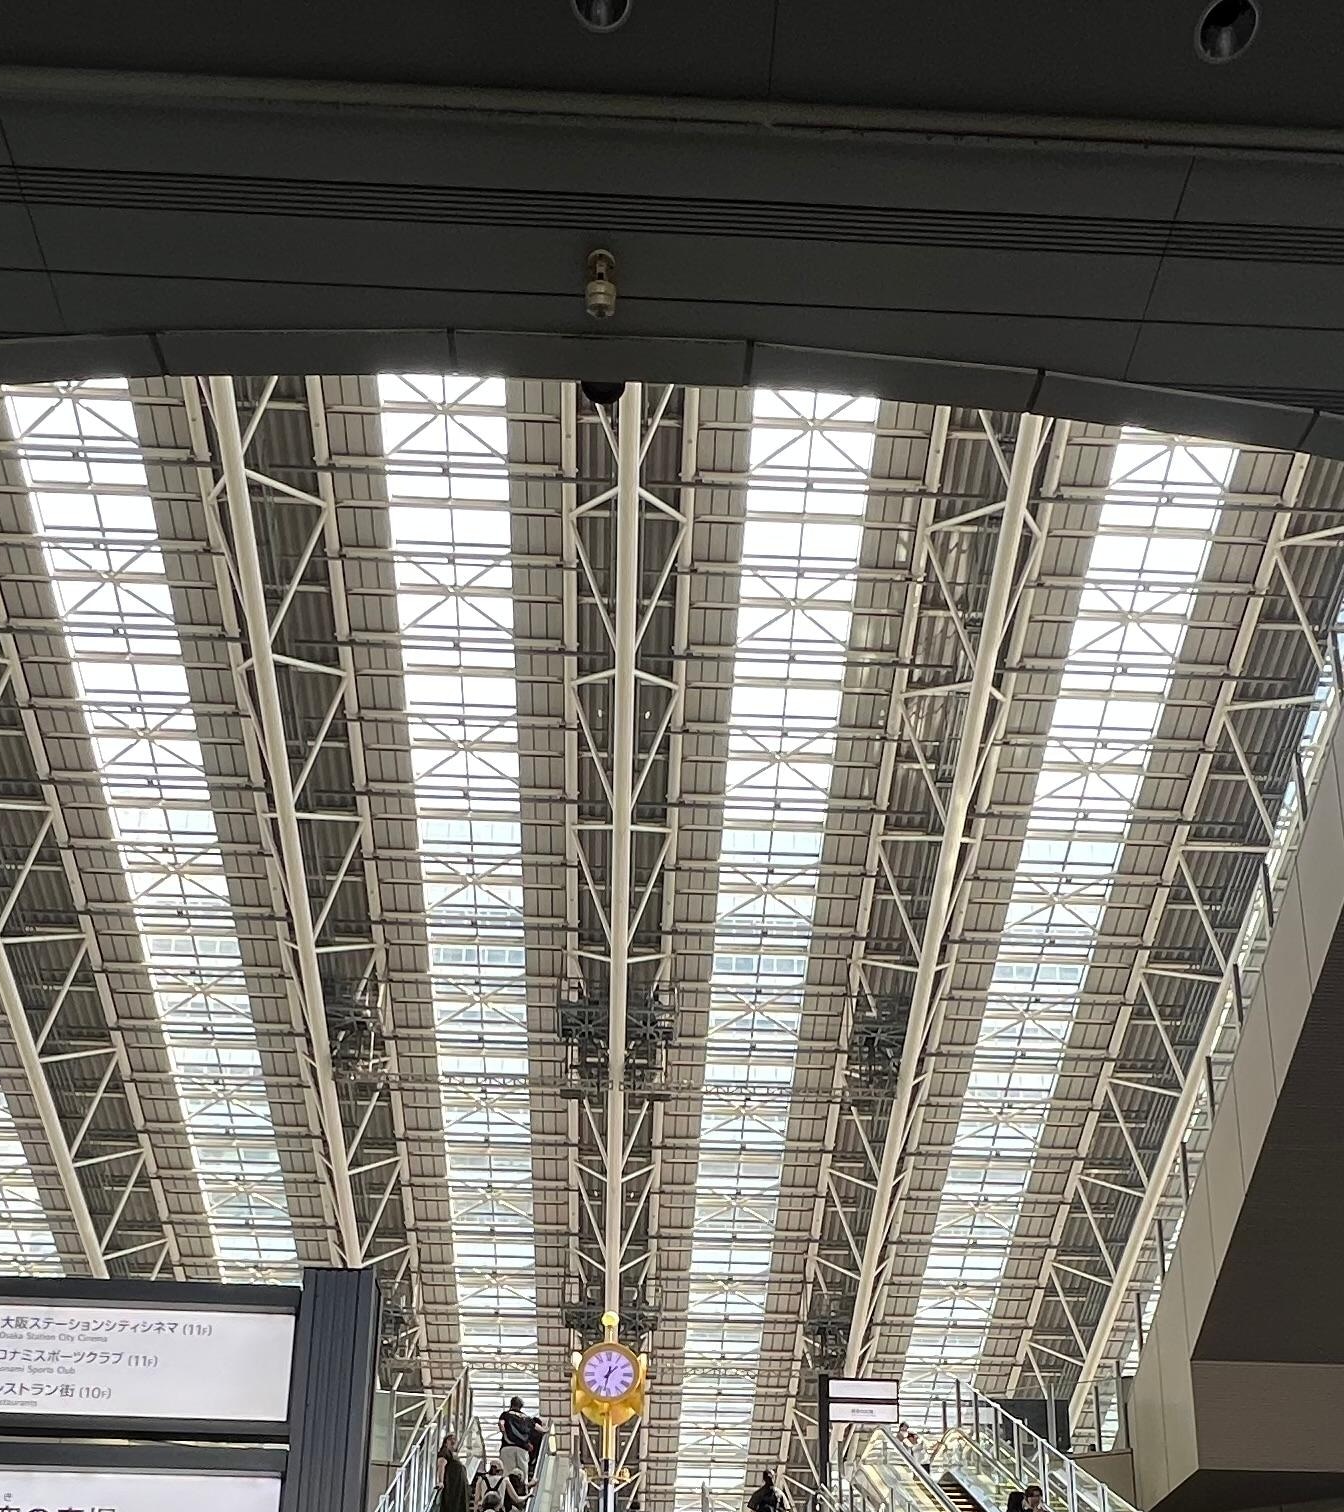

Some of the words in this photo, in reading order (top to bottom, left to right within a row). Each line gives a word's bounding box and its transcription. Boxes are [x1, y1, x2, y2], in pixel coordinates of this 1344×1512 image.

[0, 1315, 179, 1335] 大阪ステーションシティシネマ
[0, 1332, 23, 1341] Osaka
[26, 1333, 56, 1342] Station
[58, 1333, 75, 1343] City
[77, 1334, 108, 1343] Cinema
[27, 1365, 54, 1375] Sports
[57, 1366, 76, 1375] Club
